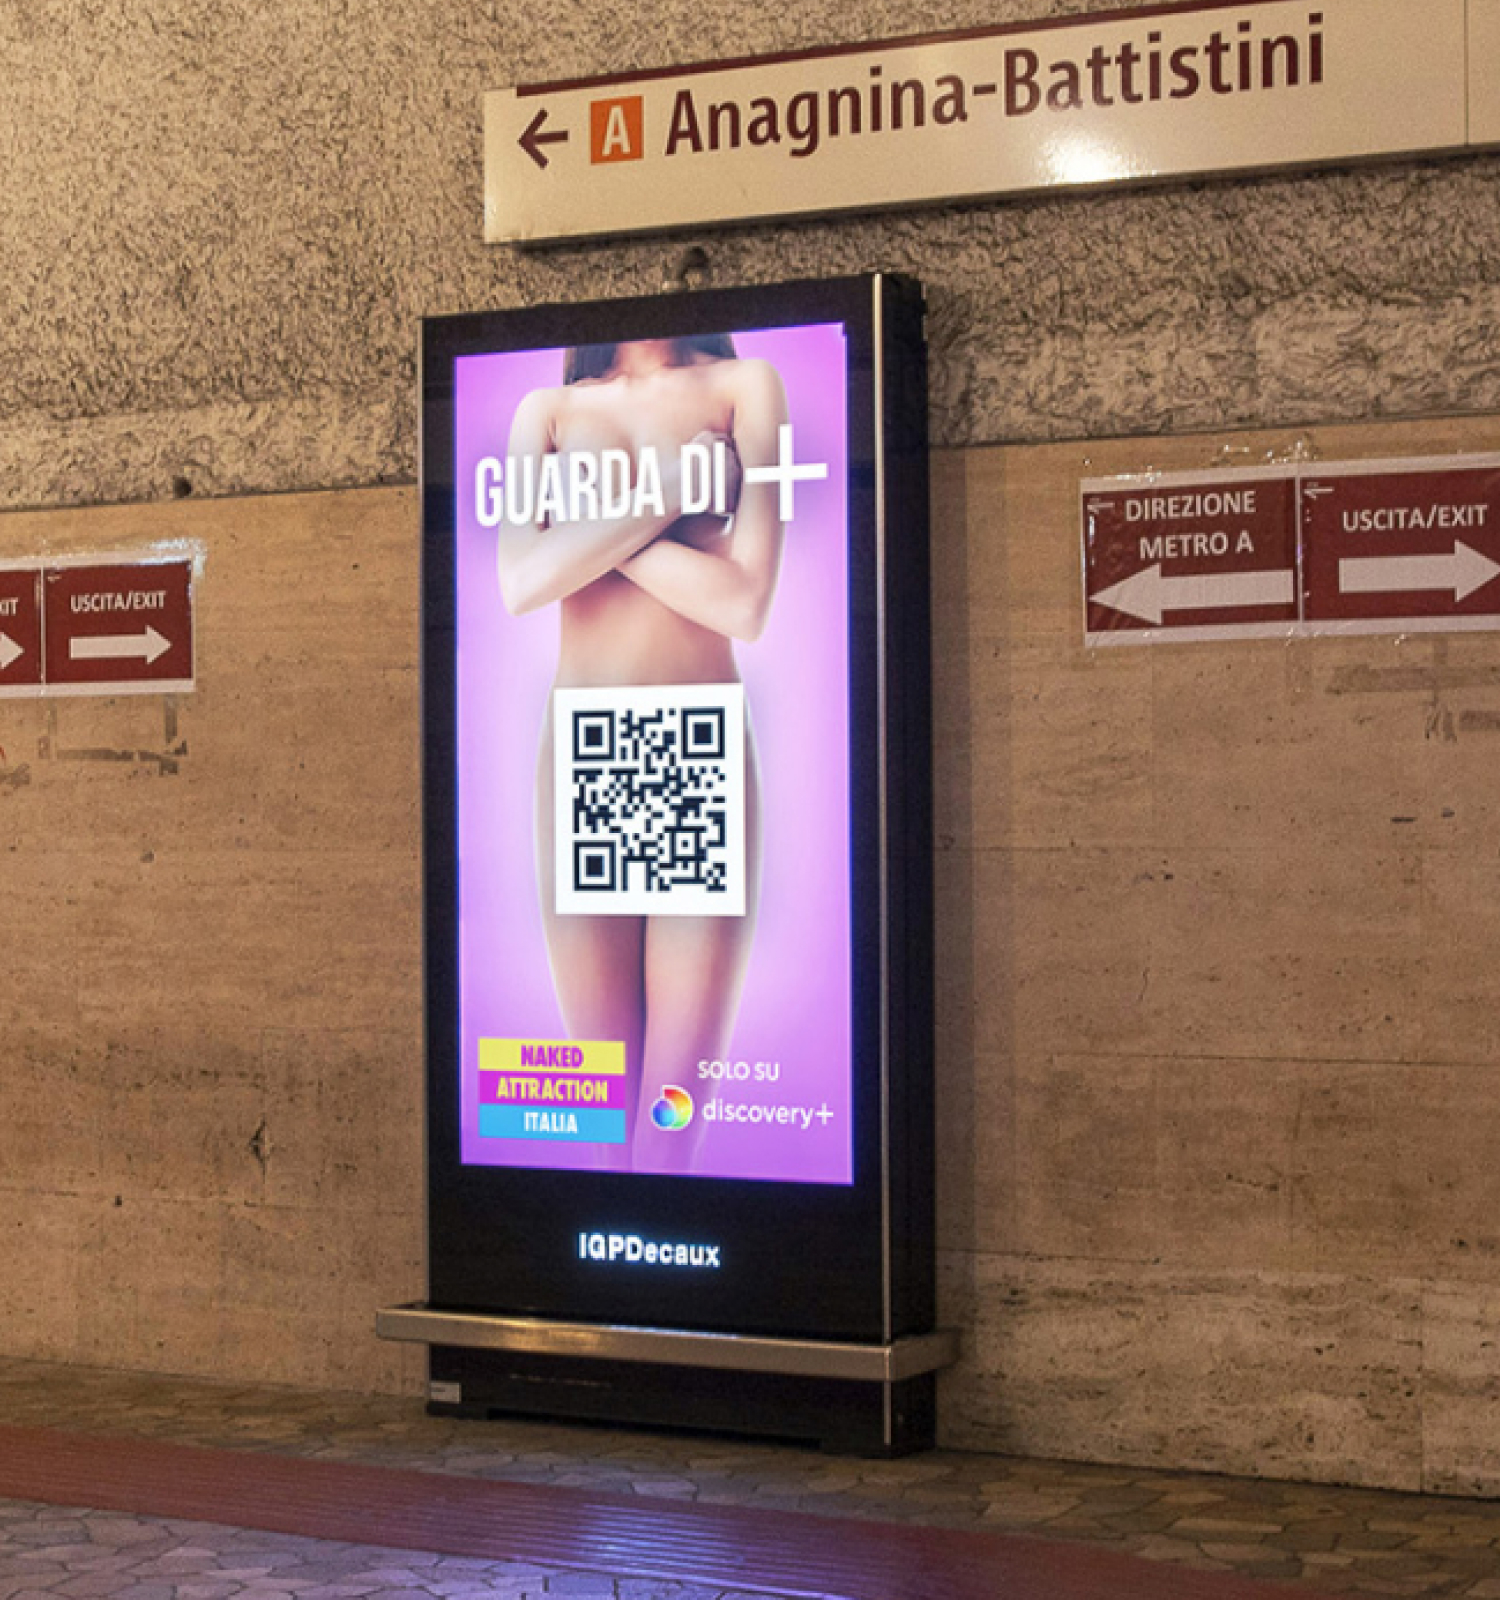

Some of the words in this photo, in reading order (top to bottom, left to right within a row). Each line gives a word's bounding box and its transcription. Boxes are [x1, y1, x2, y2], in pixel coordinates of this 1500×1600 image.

[600, 104, 631, 155] A
[665, 13, 1325, 157] Anagnina-Battistini
[474, 446, 666, 528] GUARDA
[680, 441, 727, 518] DI
[1125, 490, 1257, 522] DIREZIONE
[1342, 504, 1490, 533] USCITA/EXIT
[1139, 532, 1231, 560] METRO
[1235, 530, 1255, 555] A
[70, 589, 167, 613] USCITA/EXIT
[520, 1044, 584, 1069] NAKED
[697, 1060, 751, 1081] SOLO
[754, 1061, 780, 1082] SU
[497, 1077, 608, 1103] ATTRACTION
[523, 1111, 578, 1135] ITALIA
[702, 1101, 834, 1130] discovery+
[578, 1231, 721, 1268] IGPDecaux
